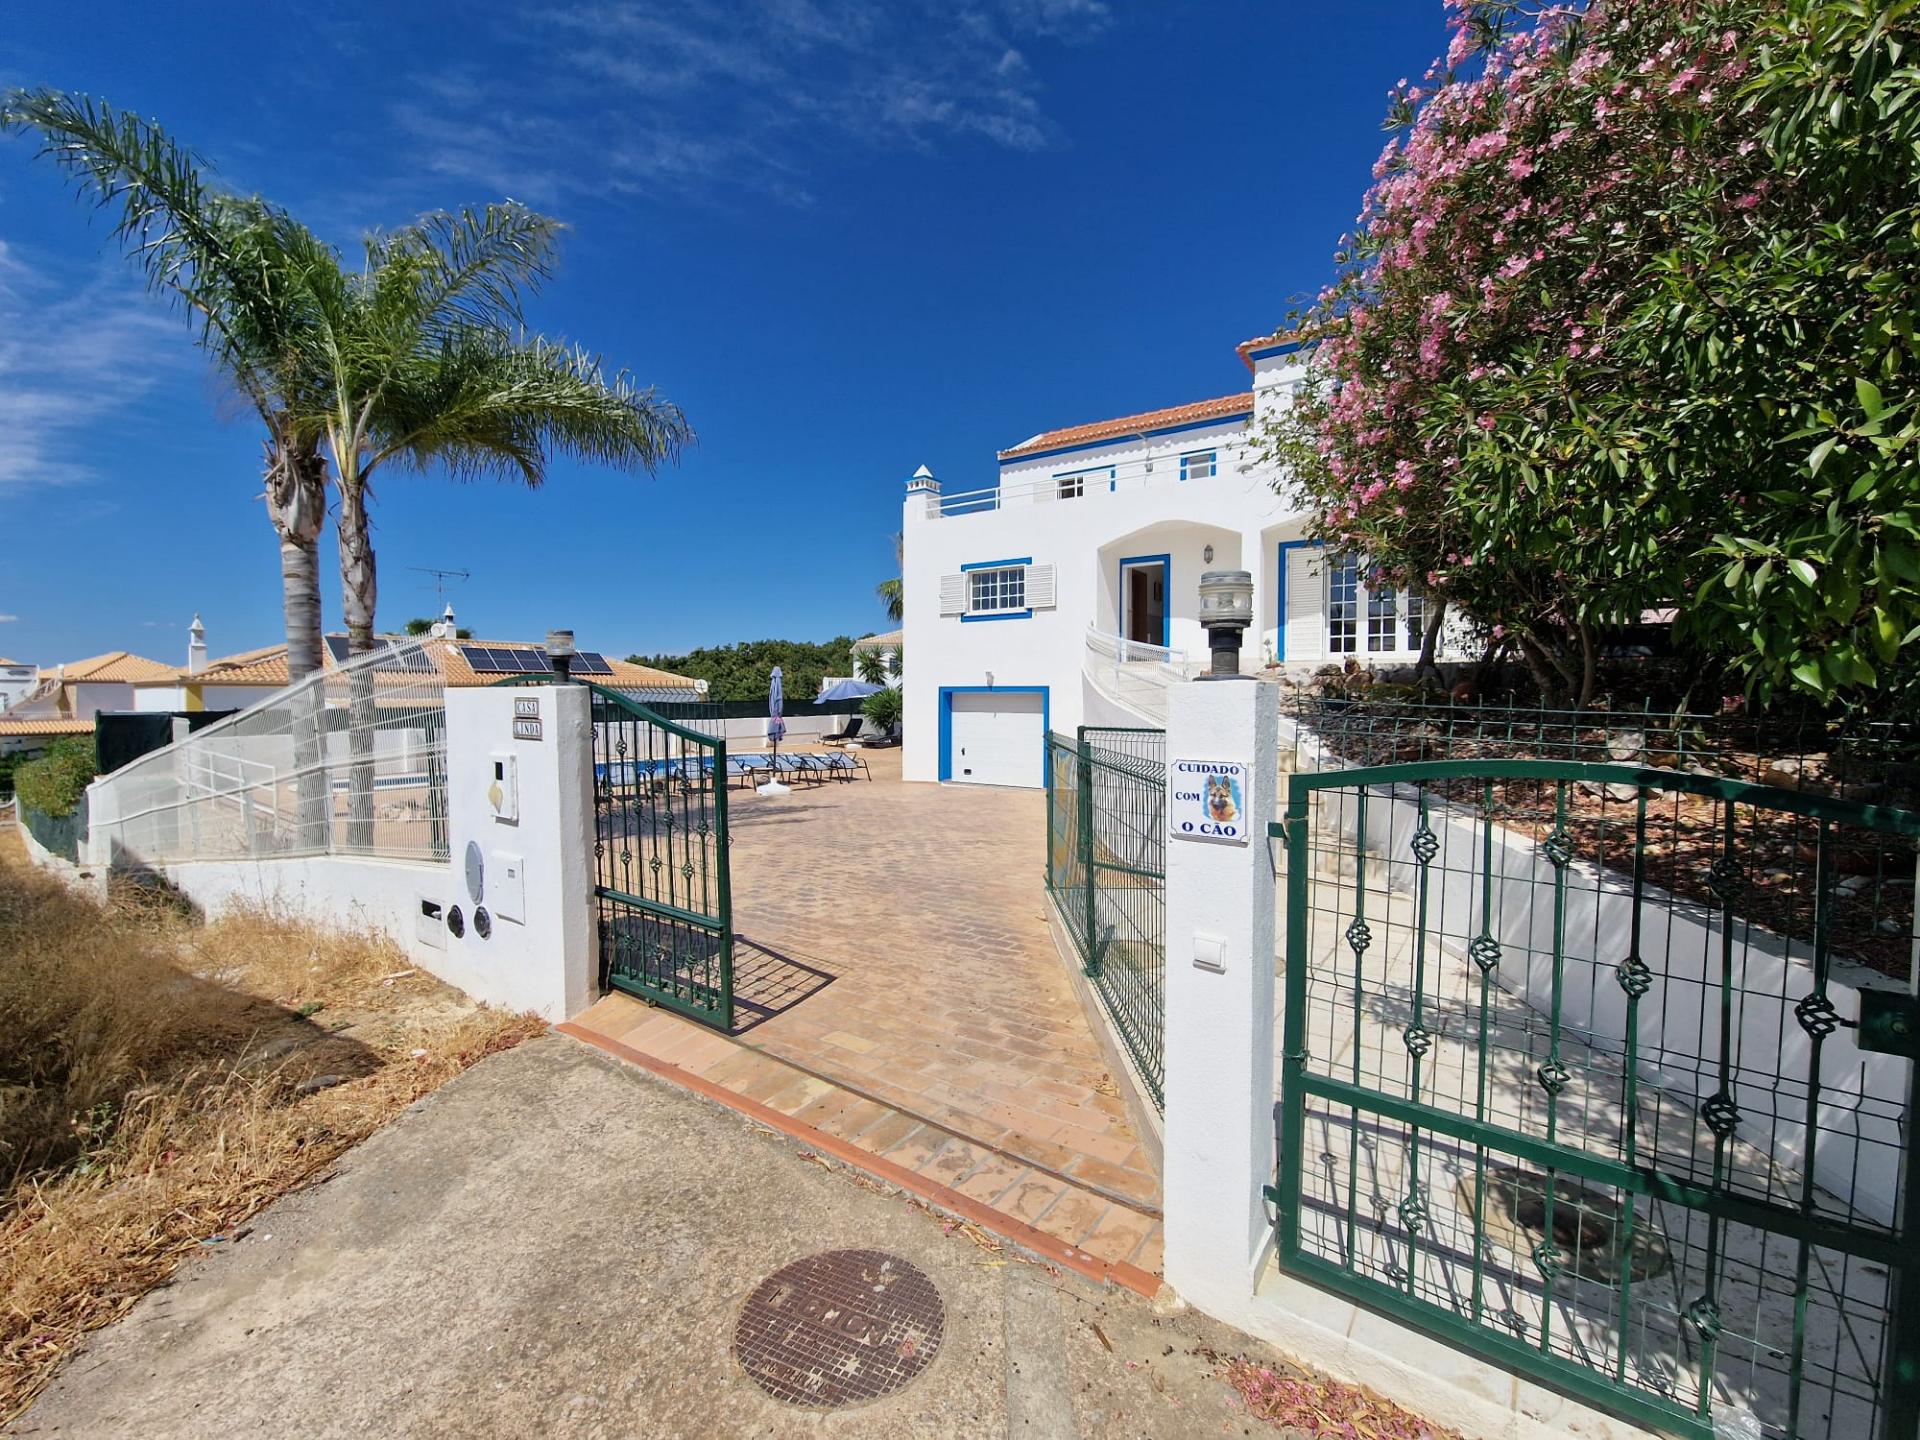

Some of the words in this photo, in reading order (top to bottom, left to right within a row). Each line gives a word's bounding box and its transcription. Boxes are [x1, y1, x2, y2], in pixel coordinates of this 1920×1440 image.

[517, 702, 536, 713] CASA
[515, 722, 539, 735] LINDA
[1178, 763, 1239, 775] CUIDADO
[1175, 791, 1200, 801] COM
[1181, 821, 1194, 832] O
[1200, 822, 1236, 836] CÃO
